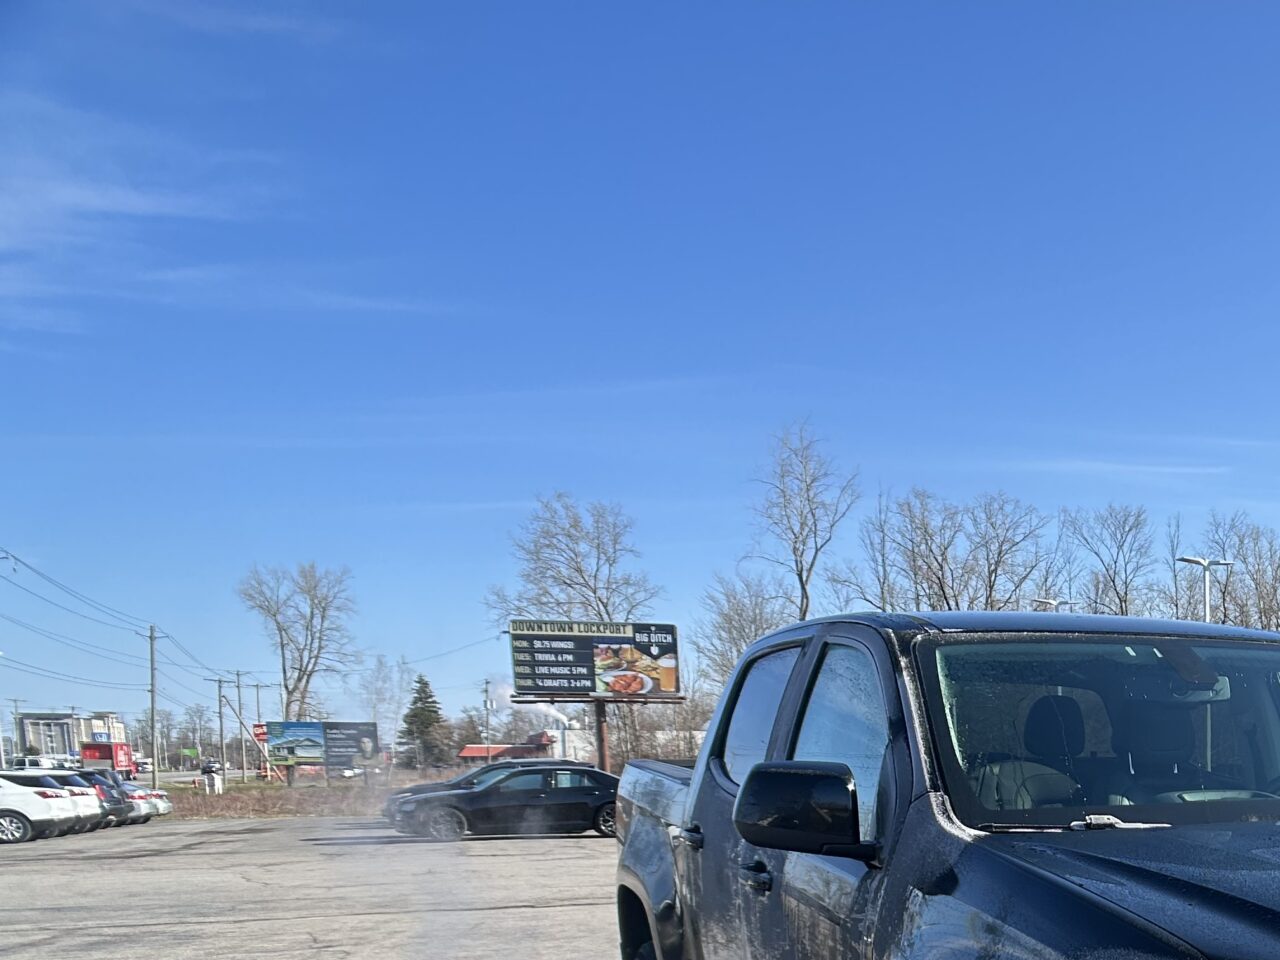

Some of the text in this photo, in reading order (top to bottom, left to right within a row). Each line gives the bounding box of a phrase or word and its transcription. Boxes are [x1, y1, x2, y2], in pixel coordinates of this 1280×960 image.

[512, 621, 628, 634] DOWNTOWN LOCKPORT
[635, 633, 672, 643] BIG DITCH
[513, 640, 530, 648] MON:
[513, 653, 532, 661] TUES:
[535, 666, 550, 674] LIVE
[544, 679, 568, 687] DRAFTS
